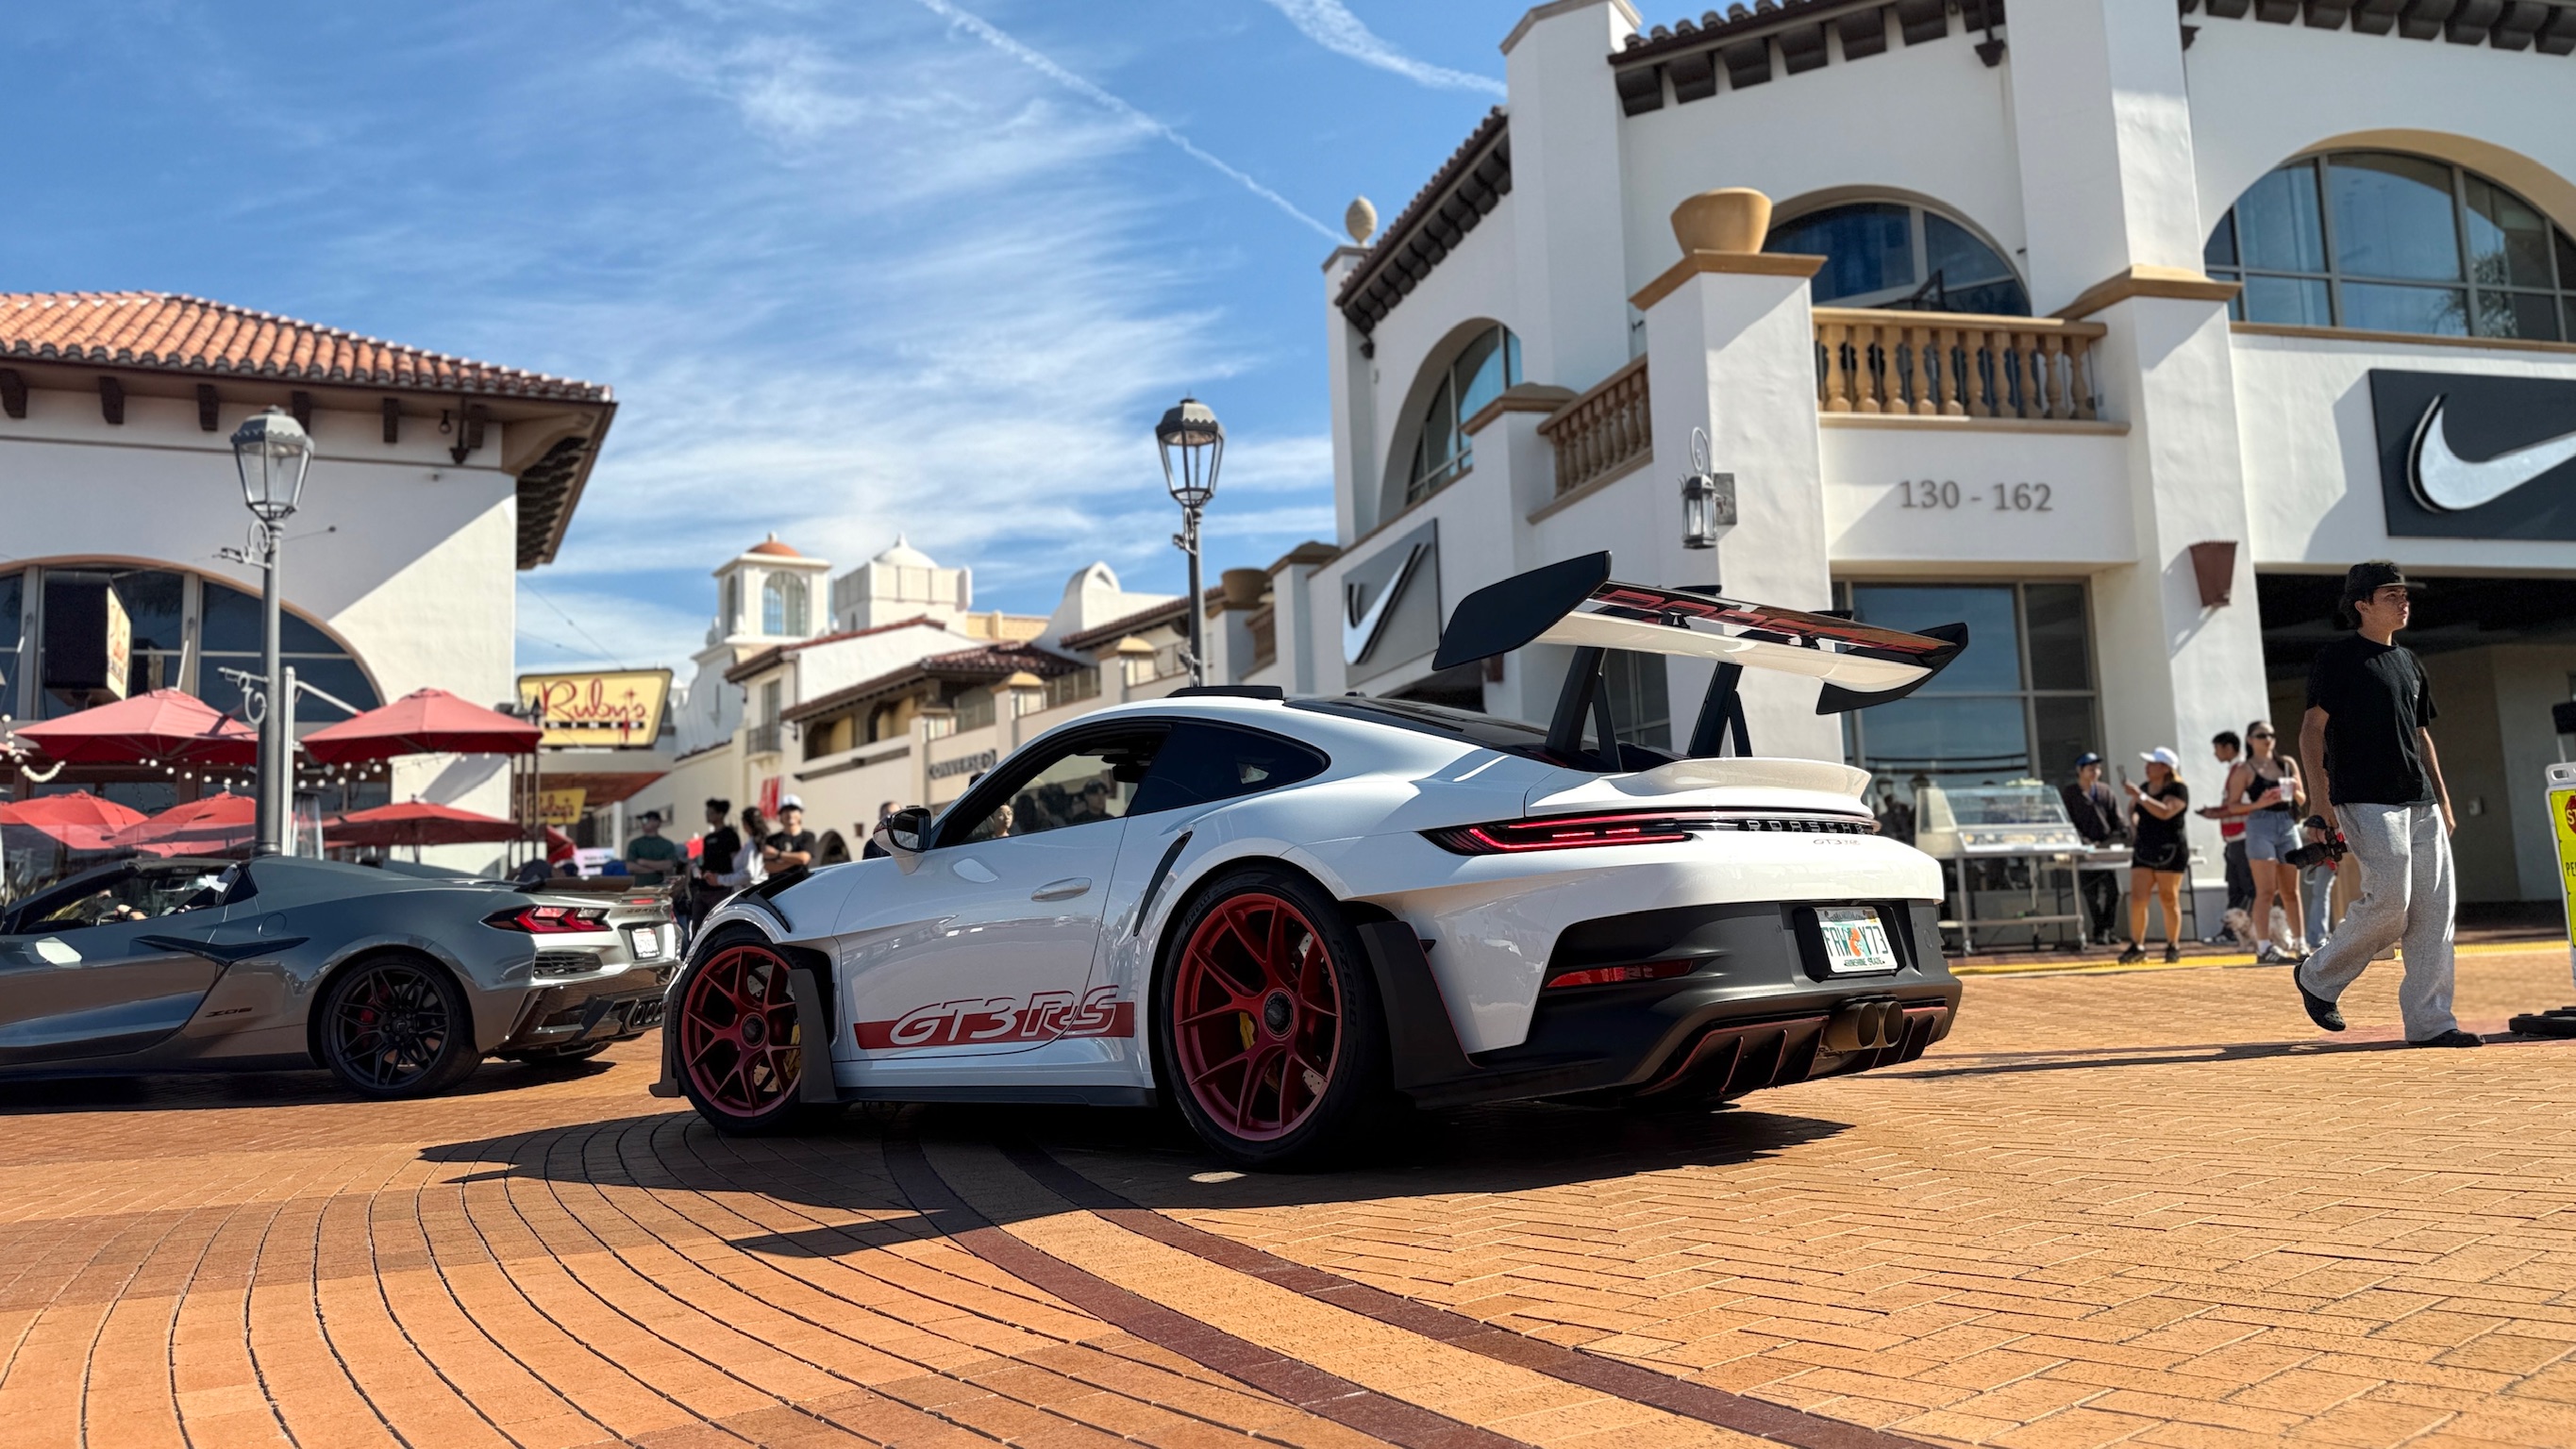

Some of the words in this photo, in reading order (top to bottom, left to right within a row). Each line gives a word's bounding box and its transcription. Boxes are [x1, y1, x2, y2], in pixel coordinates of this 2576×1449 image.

[1899, 479, 1961, 509] 130
[1993, 482, 2053, 511] 162
[539, 677, 648, 742] Ruby's
[1746, 820, 1865, 834] PORSCHE
